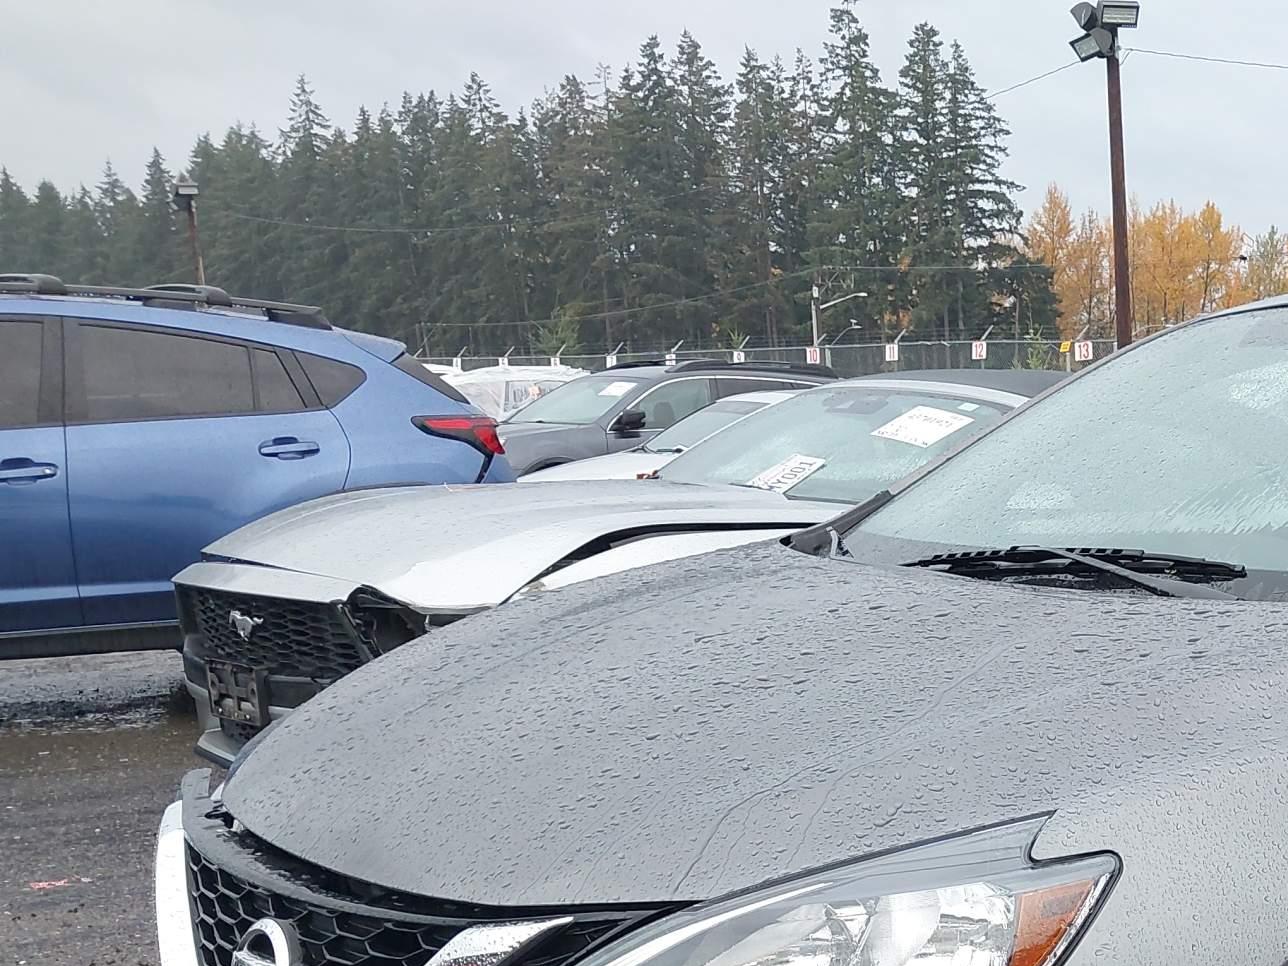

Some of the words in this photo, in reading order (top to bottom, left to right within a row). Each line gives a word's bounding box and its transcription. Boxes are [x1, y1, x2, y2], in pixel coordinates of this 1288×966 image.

[808, 347, 818, 363] 10
[888, 344, 896, 360] 11
[974, 343, 984, 359] 12
[1077, 343, 1090, 359] 13
